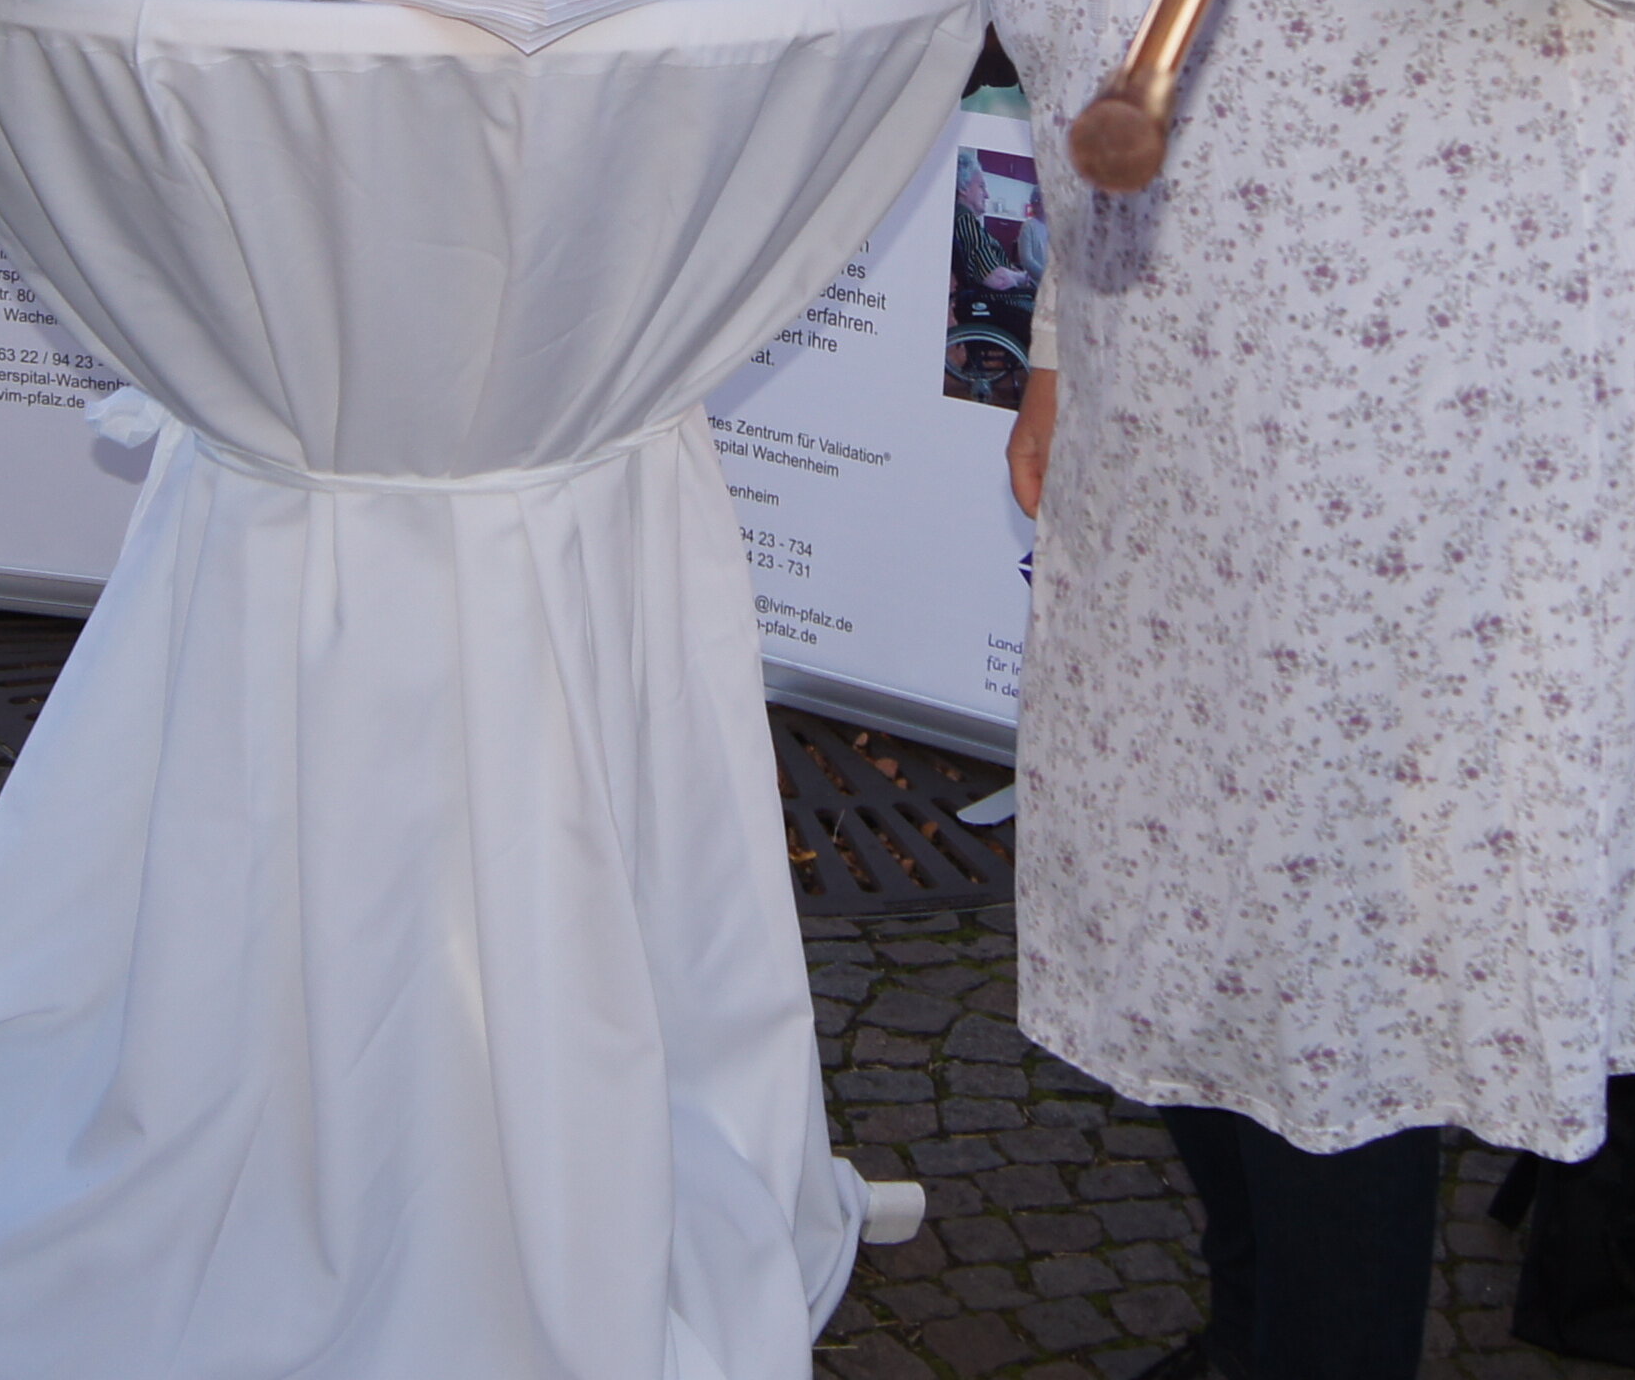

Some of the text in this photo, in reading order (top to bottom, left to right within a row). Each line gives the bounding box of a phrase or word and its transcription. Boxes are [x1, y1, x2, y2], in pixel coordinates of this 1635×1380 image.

[17, 288, 35, 303] 80
[807, 308, 878, 335] erfahren.
[808, 332, 837, 352] ihre
[20, 349, 38, 364] 22
[42, 351, 49, 365] /
[52, 352, 70, 367] 94
[76, 354, 93, 369] 23
[736, 420, 793, 445] Zentrum
[798, 433, 815, 449] für
[714, 438, 839, 478] spital Wachenheim
[726, 484, 779, 506] enheim
[758, 531, 775, 548] 23
[789, 538, 812, 557] 734
[746, 550, 752, 564] 4
[757, 552, 774, 570] 23
[787, 560, 811, 578] 731
[755, 595, 853, 633] @lvim-pfalz.de
[988, 632, 1023, 655] Land
[987, 655, 1007, 672] für
[985, 678, 1020, 698] in de
